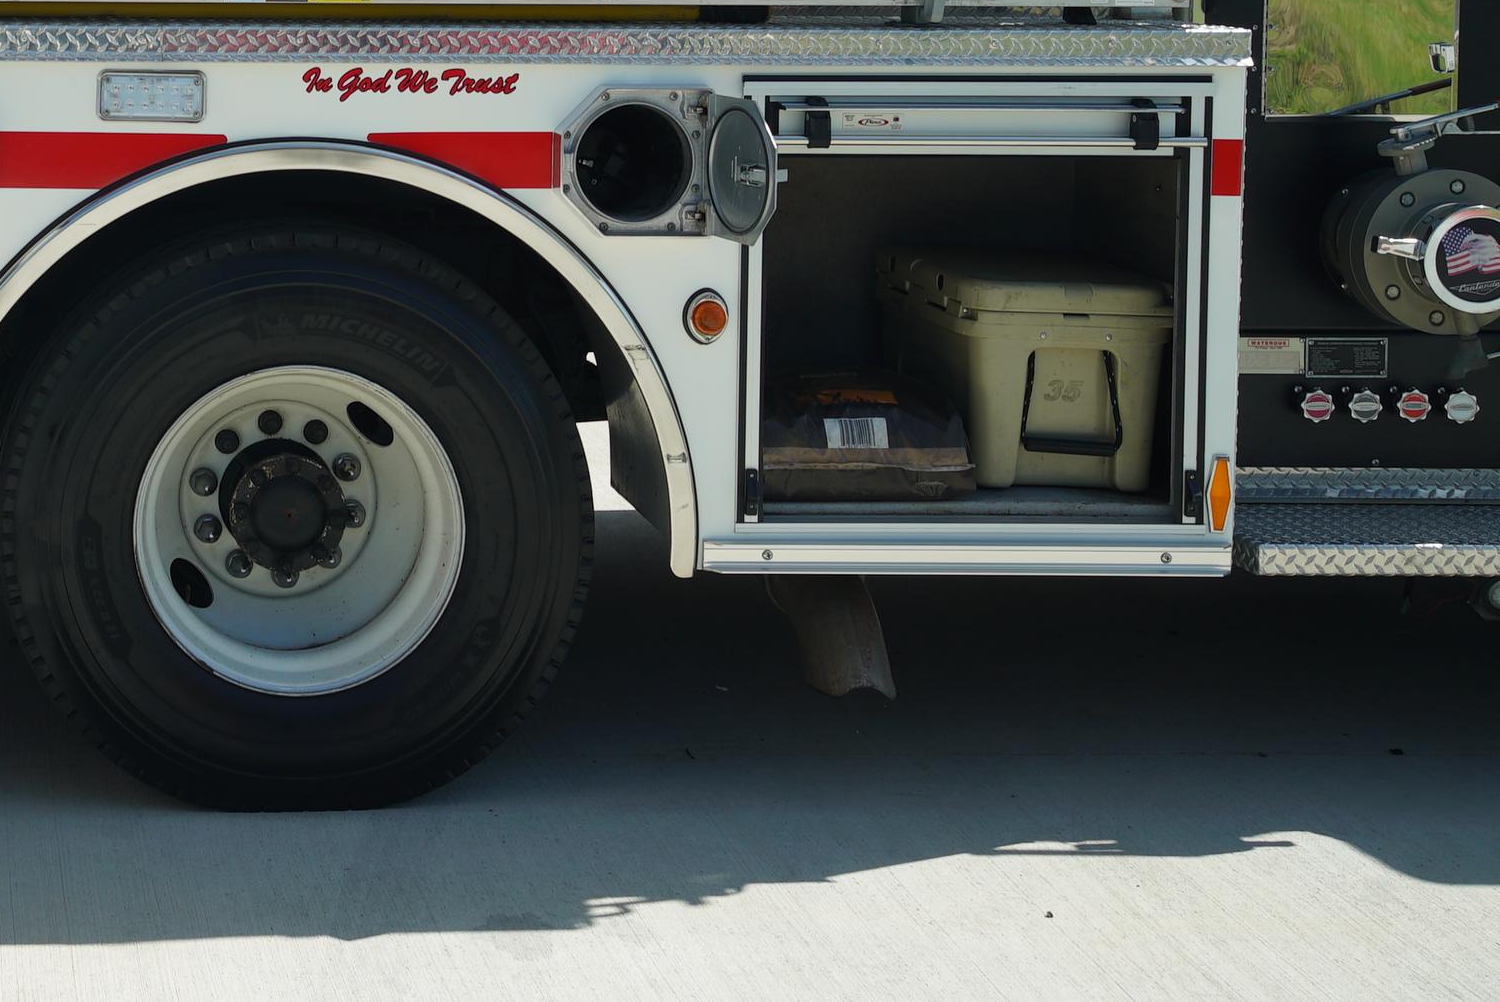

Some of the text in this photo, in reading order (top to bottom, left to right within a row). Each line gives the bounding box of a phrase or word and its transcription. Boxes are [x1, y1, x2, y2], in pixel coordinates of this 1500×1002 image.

[302, 66, 520, 102] In God We Trust
[301, 313, 443, 372] MICHELIN
[1043, 379, 1085, 403] 35
